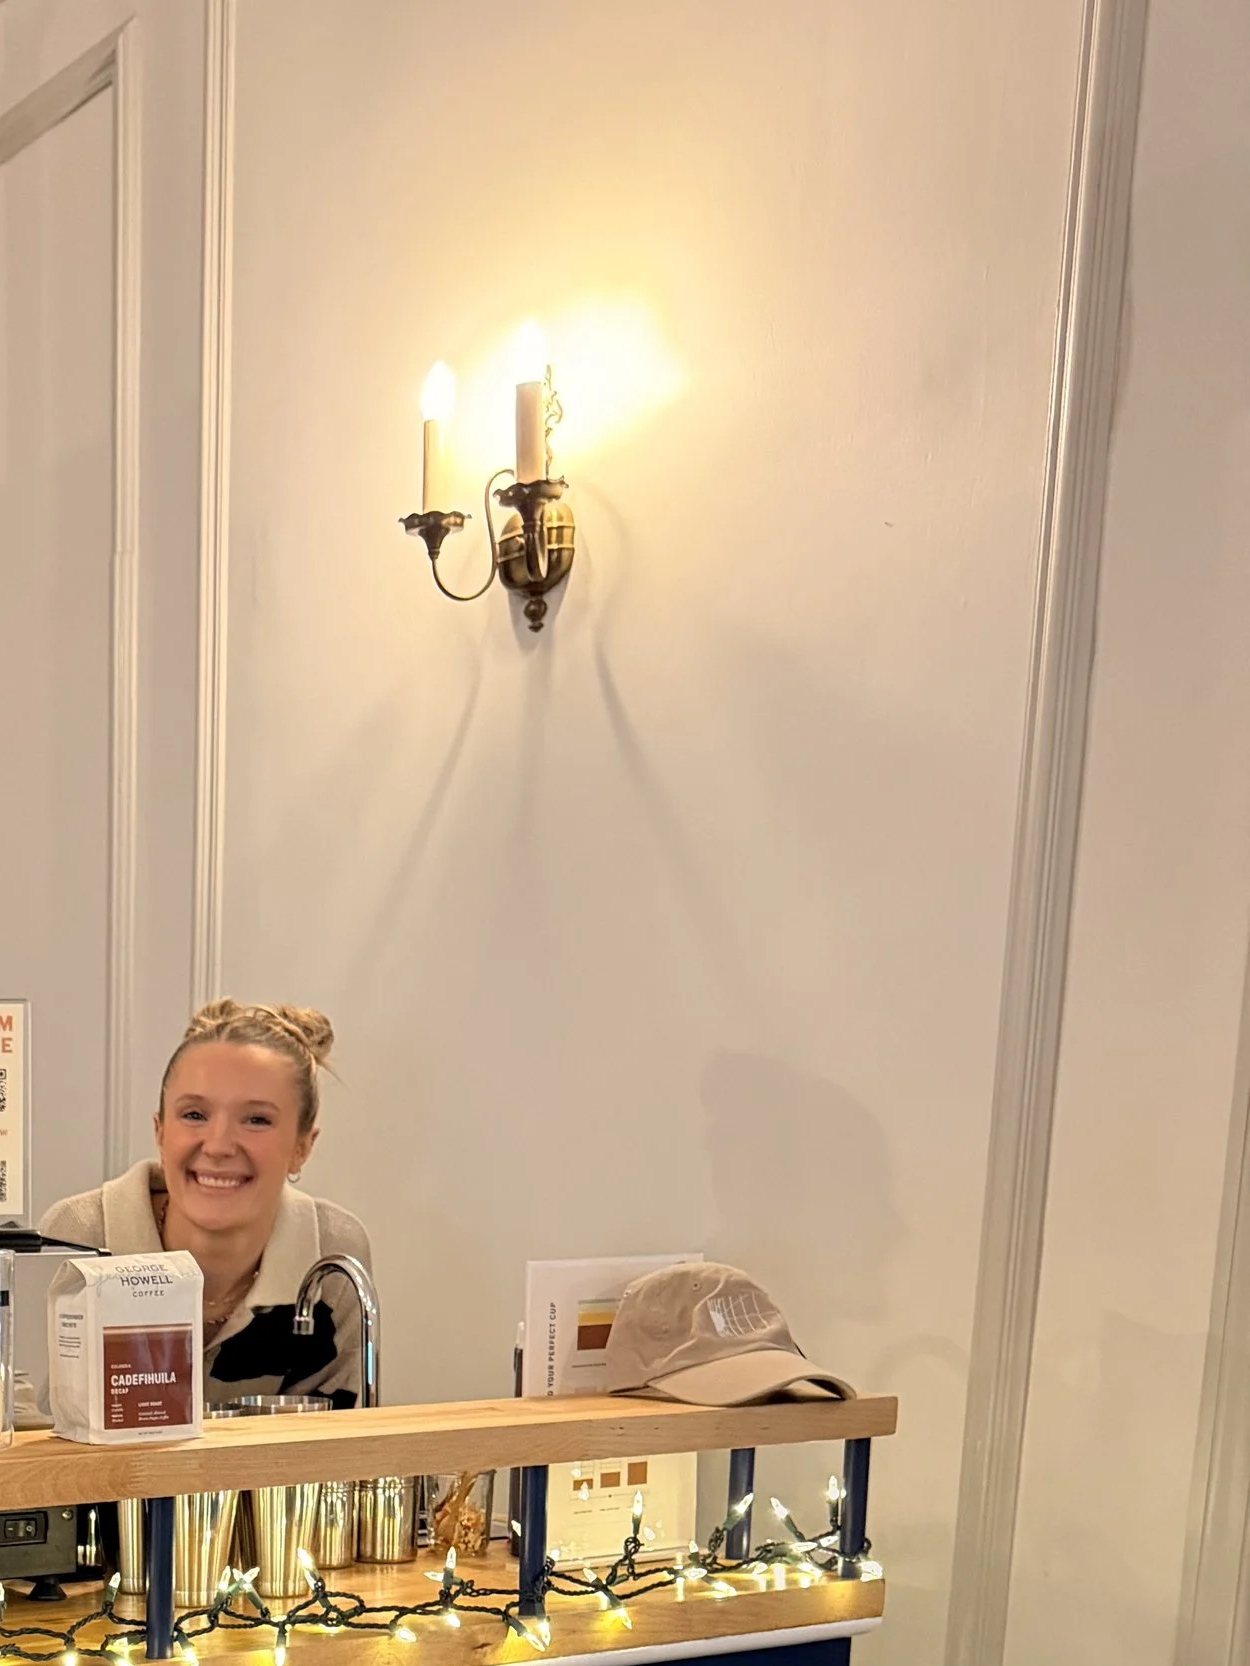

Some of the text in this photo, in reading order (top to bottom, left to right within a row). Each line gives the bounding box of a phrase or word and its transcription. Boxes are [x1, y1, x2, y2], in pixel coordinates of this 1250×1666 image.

[115, 1264, 168, 1274] GEORGE
[121, 1275, 173, 1287] HOWELL
[132, 1289, 165, 1298] COFFEE
[548, 1323, 556, 1361] PERFECT
[111, 1372, 176, 1386] CADEFIHUILA
[547, 1365, 555, 1388] YOUR
